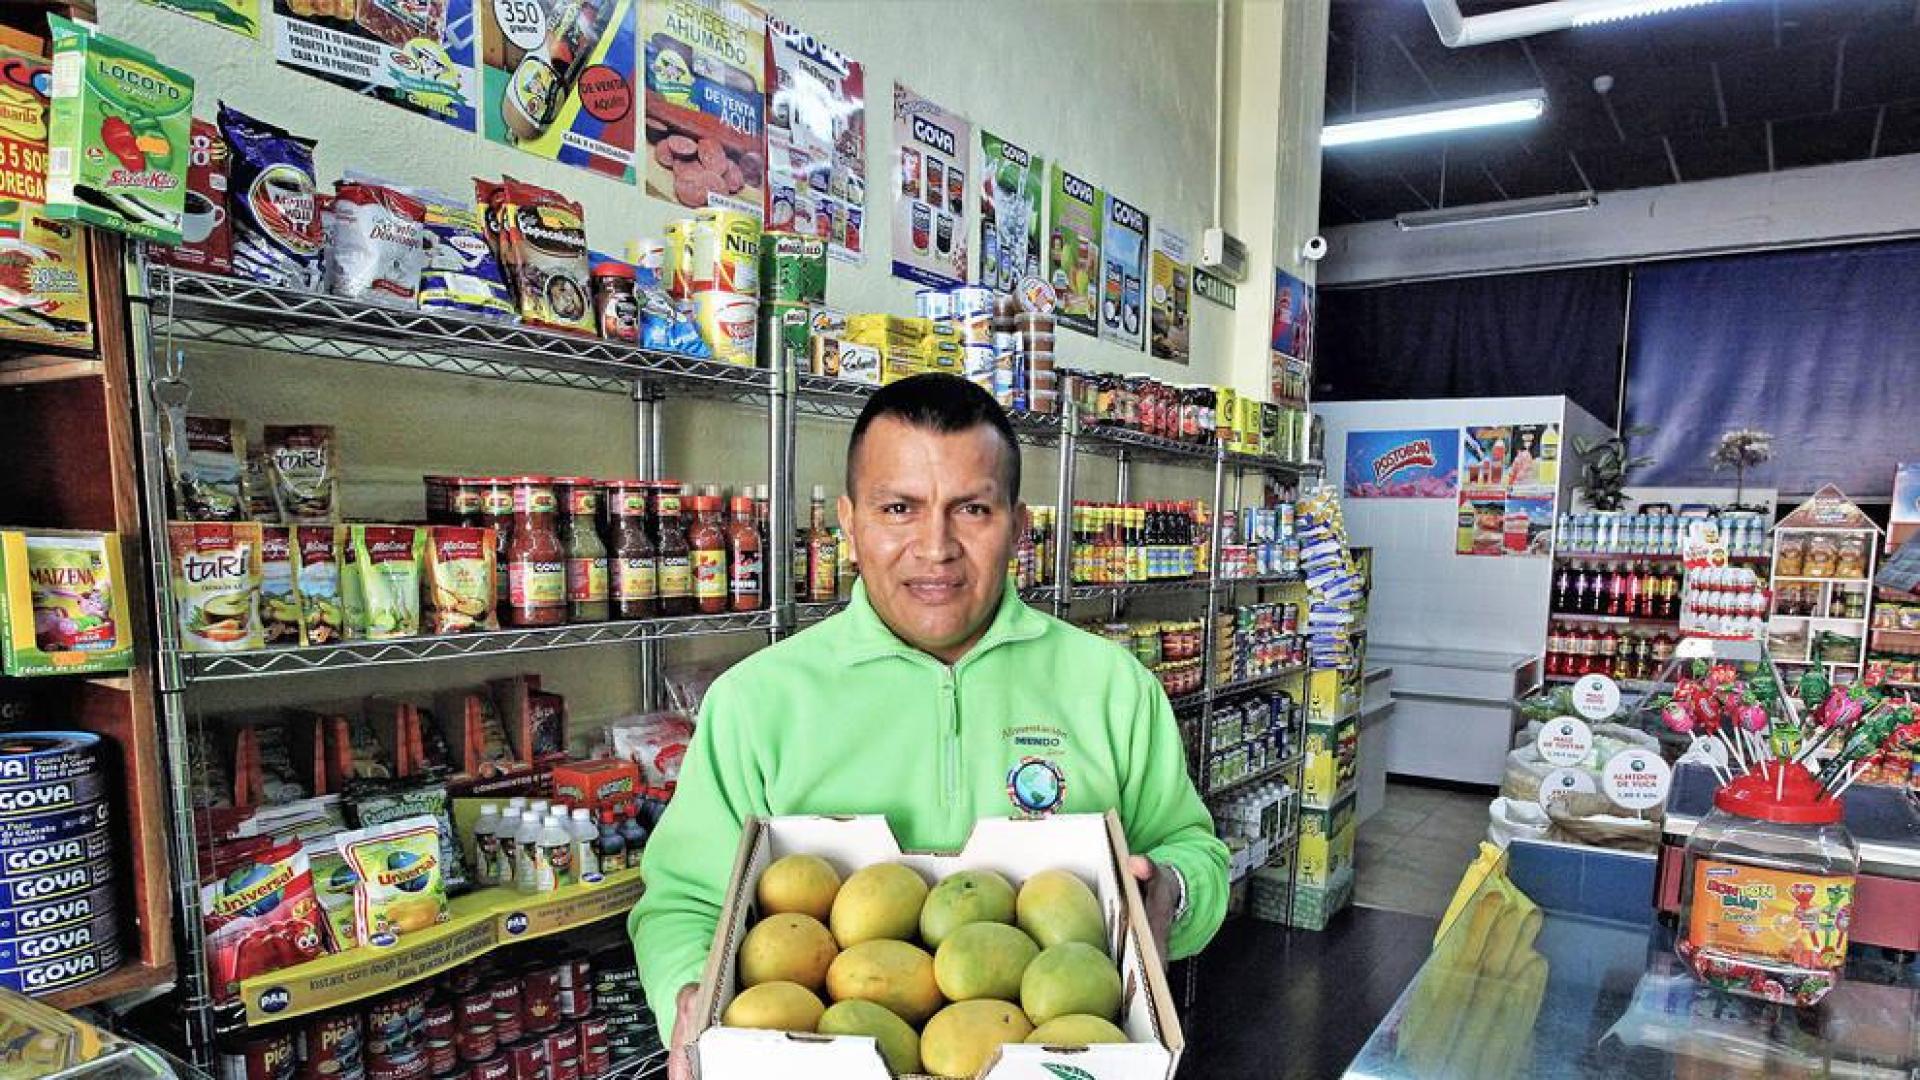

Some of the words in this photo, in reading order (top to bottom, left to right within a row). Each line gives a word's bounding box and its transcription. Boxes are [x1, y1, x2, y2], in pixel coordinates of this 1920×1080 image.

[505, 1, 539, 24] 350
[666, 15, 746, 64] AHUMADO
[98, 60, 180, 99] LOCOTO
[594, 79, 628, 92] VENTA
[705, 86, 723, 104] DE
[722, 93, 756, 119] VENTA
[914, 119, 955, 156] GOYA
[9, 143, 19, 168] 5
[1003, 143, 1027, 166] GOYA
[1064, 175, 1094, 203] GOYA
[1114, 202, 1144, 234] GOYA
[31, 568, 96, 585] MAIZENA
[0, 784, 70, 809] GOYA
[8, 840, 81, 869] GOYA
[16, 869, 87, 898] GOYA
[376, 854, 437, 885] Universal
[20, 899, 91, 928] GOYA
[507, 916, 528, 931] PAN
[20, 926, 91, 957] GOYA
[26, 955, 96, 985] GOYA
[310, 975, 345, 991] Instant
[261, 992, 290, 1009] PAN
